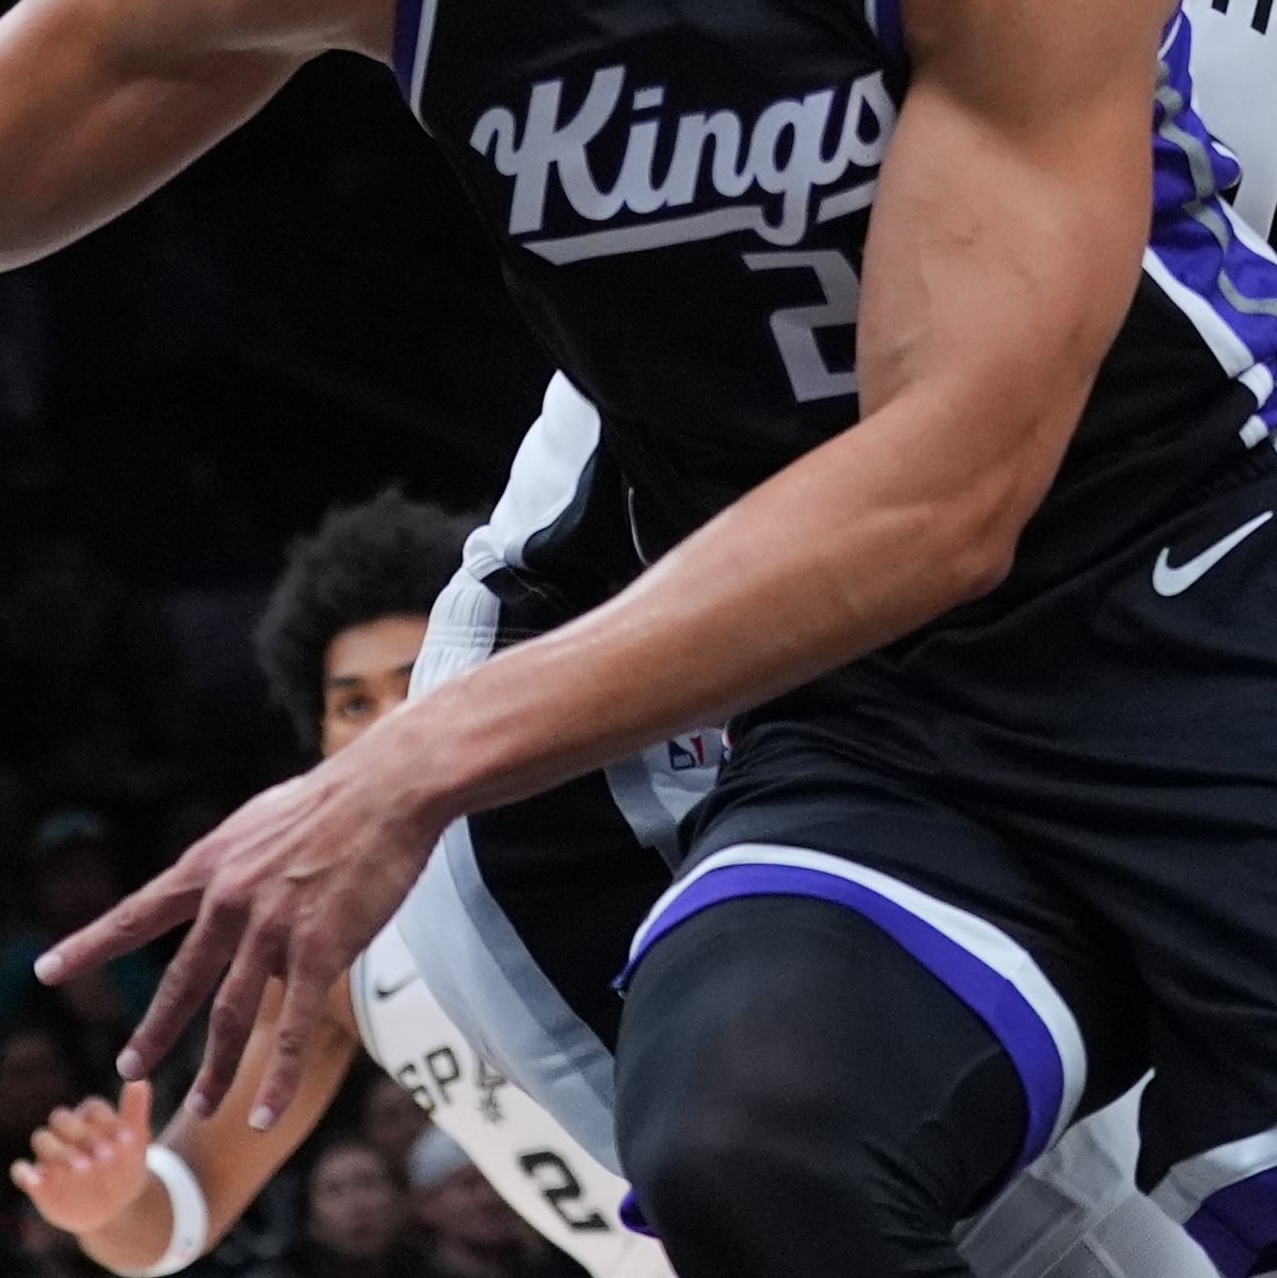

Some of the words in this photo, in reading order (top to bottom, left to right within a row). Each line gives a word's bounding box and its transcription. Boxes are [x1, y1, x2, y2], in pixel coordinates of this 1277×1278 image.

[469, 64, 900, 246] Kings
[741, 250, 860, 403] 2
[520, 1150, 611, 1232] 2
